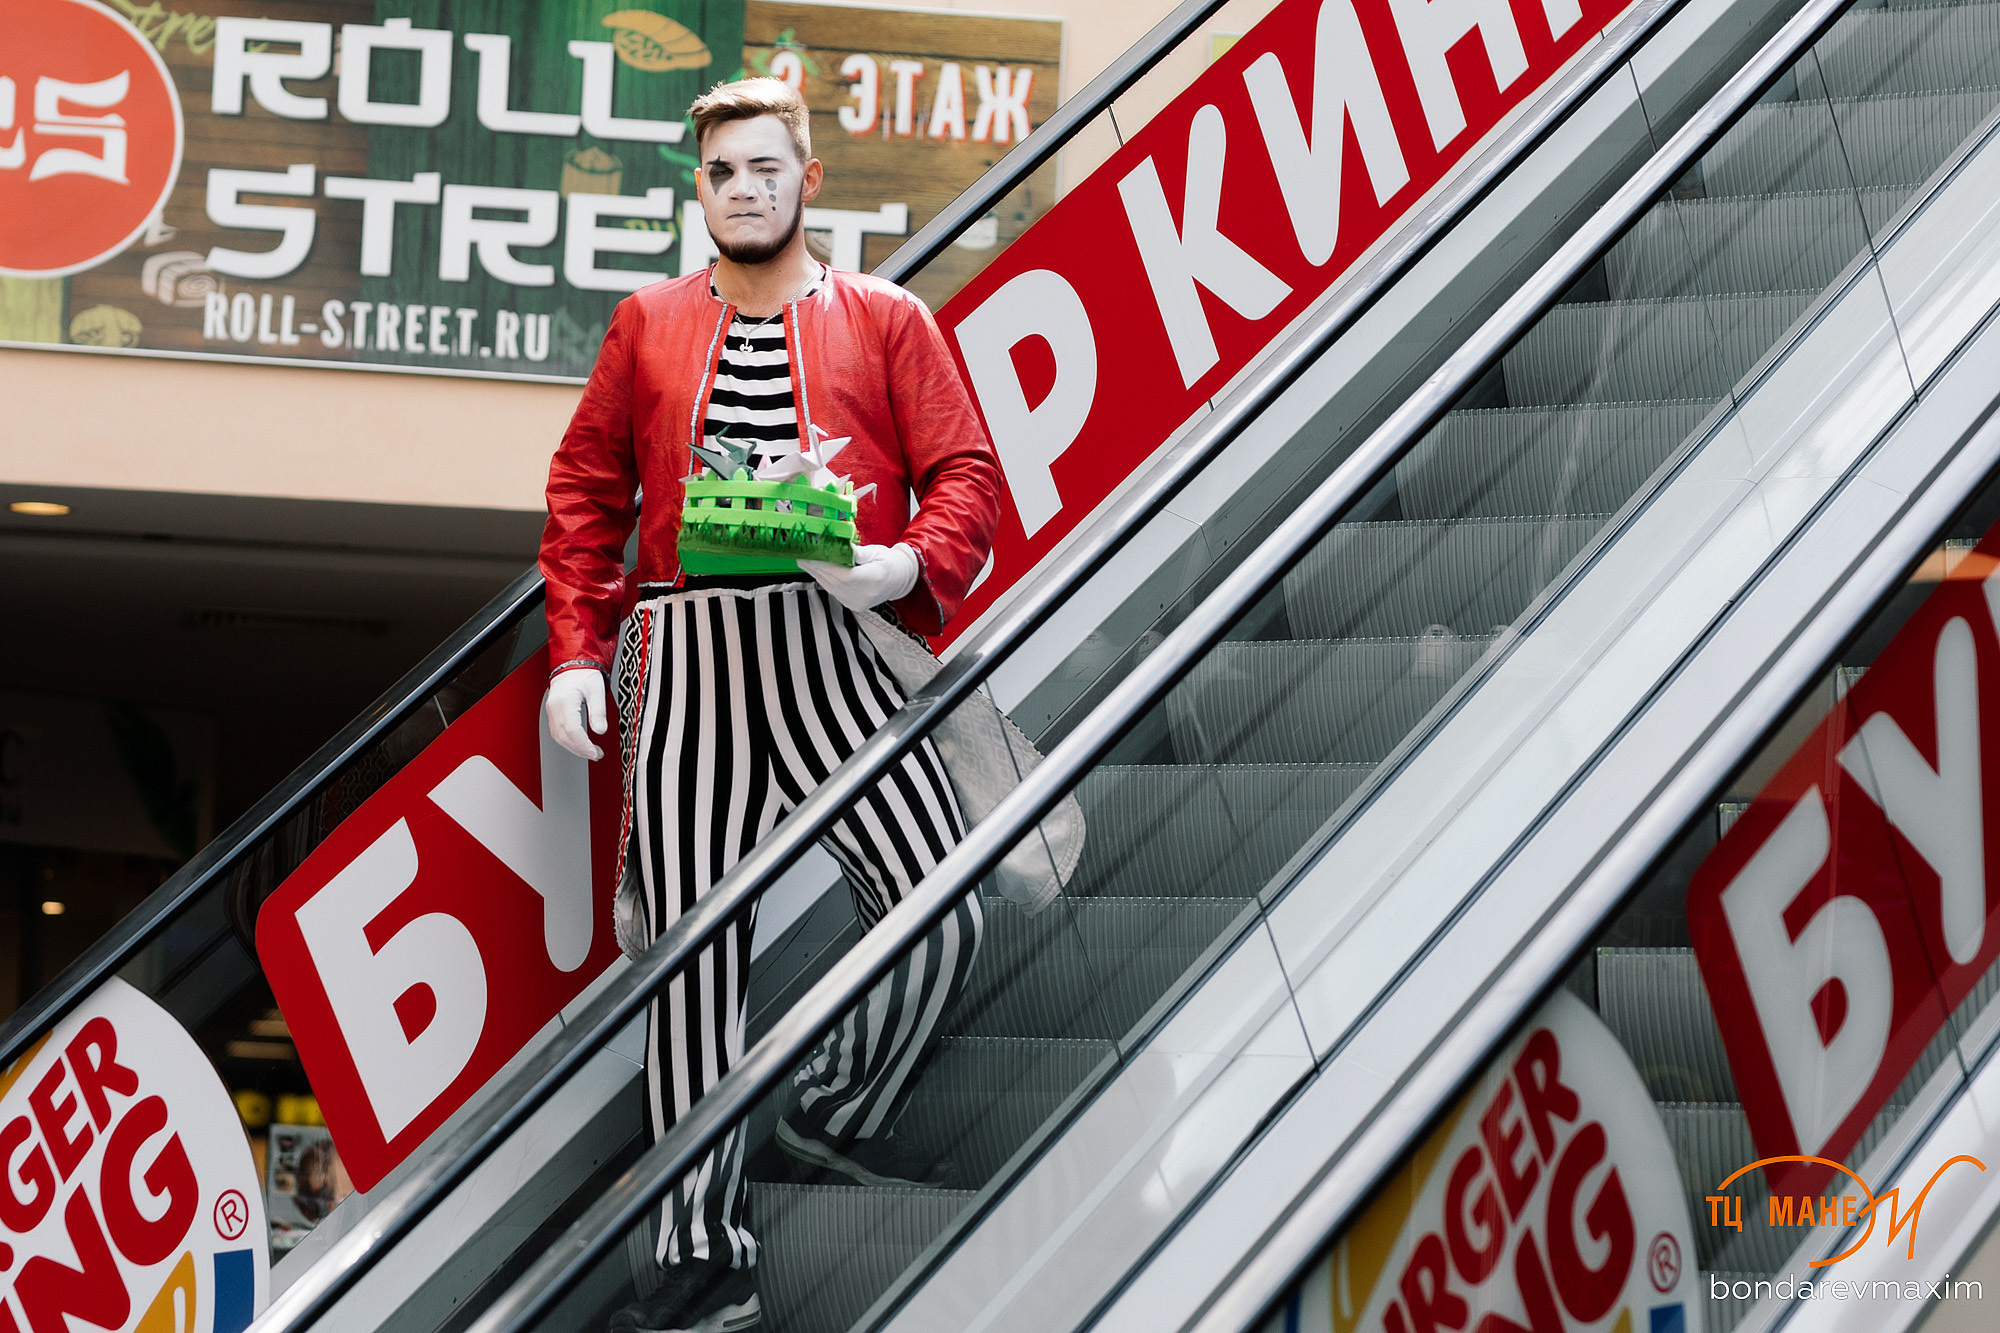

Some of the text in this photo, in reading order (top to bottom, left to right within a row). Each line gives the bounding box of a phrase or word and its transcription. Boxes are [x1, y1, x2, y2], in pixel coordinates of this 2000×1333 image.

[210, 15, 687, 144] ROLL
[838, 53, 1035, 146] ЭТАЖ
[1116, 0, 1583, 391] КИН
[203, 291, 551, 361] ROLL-STREET.RU
[1383, 1027, 1582, 1333] RGER
